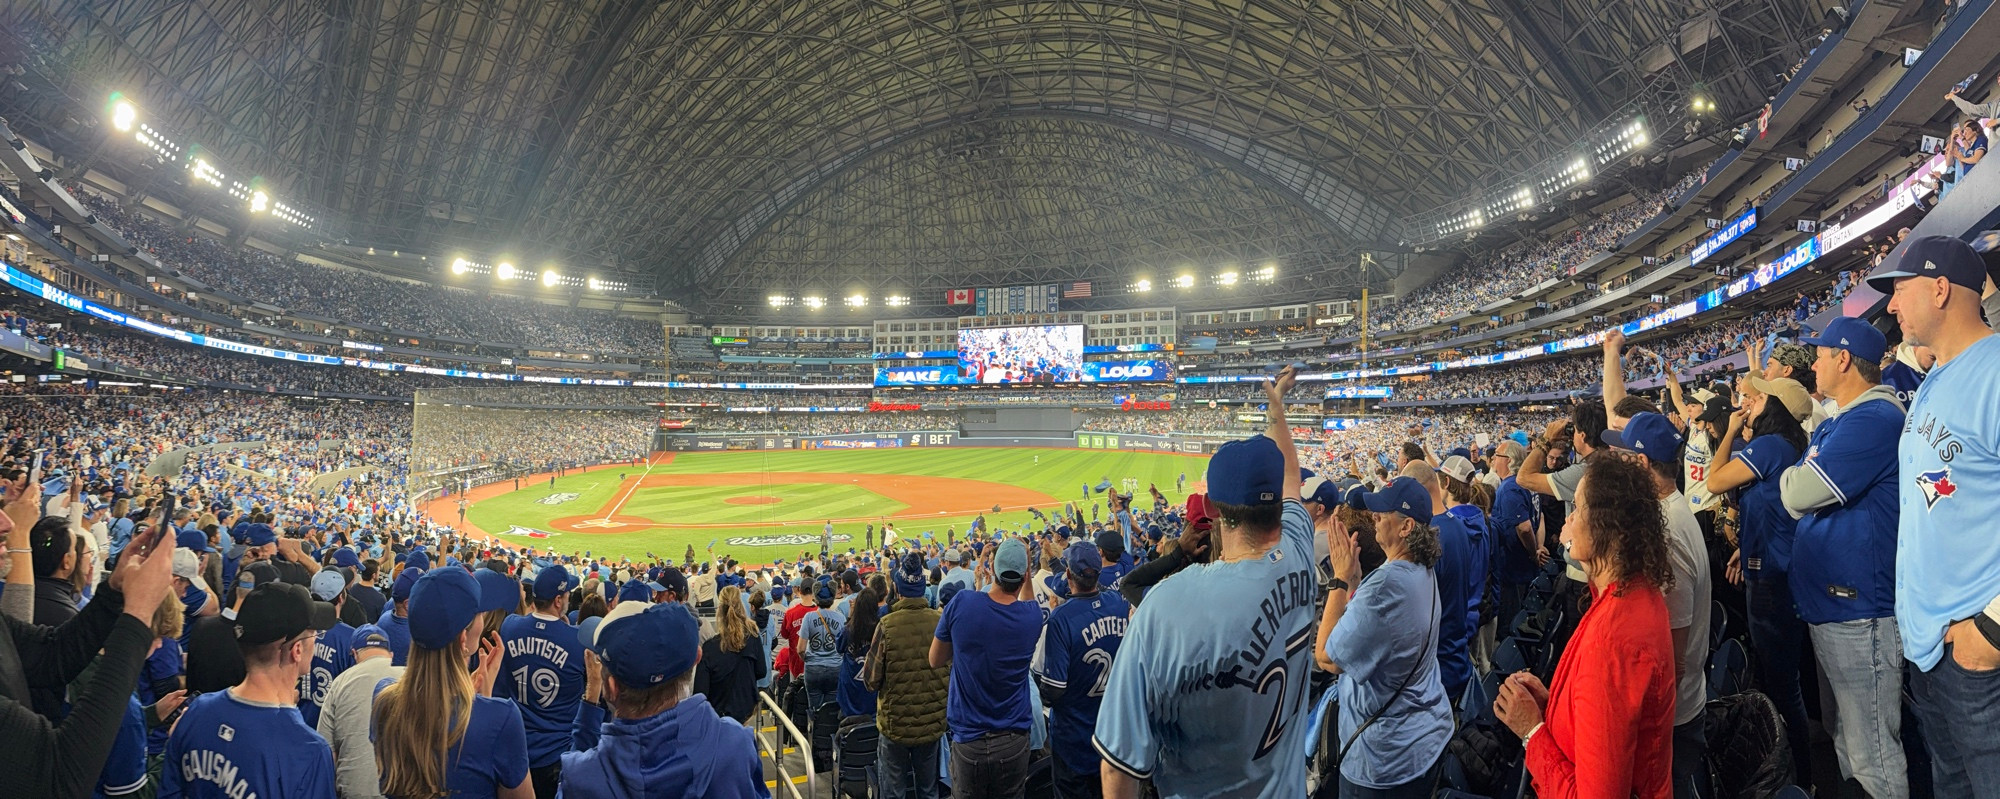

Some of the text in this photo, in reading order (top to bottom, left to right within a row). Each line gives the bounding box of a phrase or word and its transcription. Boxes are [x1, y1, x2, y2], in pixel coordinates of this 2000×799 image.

[1896, 195, 1905, 210] 63
[1727, 248, 1810, 297] GET LOUD
[888, 366, 1153, 382] MAKE LOUD
[868, 400, 922, 412] Budweiser
[1133, 401, 1171, 410] ROGERS
[929, 434, 952, 445] BET
[1916, 412, 1963, 463] JAYS
[1690, 464, 1704, 482] 21
[813, 617, 840, 631] ROANO
[809, 631, 836, 652] 68
[507, 637, 569, 669] BAUTISTA
[1081, 647, 1113, 698] 2
[301, 666, 333, 707] 13
[511, 665, 560, 709] 19
[181, 749, 257, 799] GAUSMA
